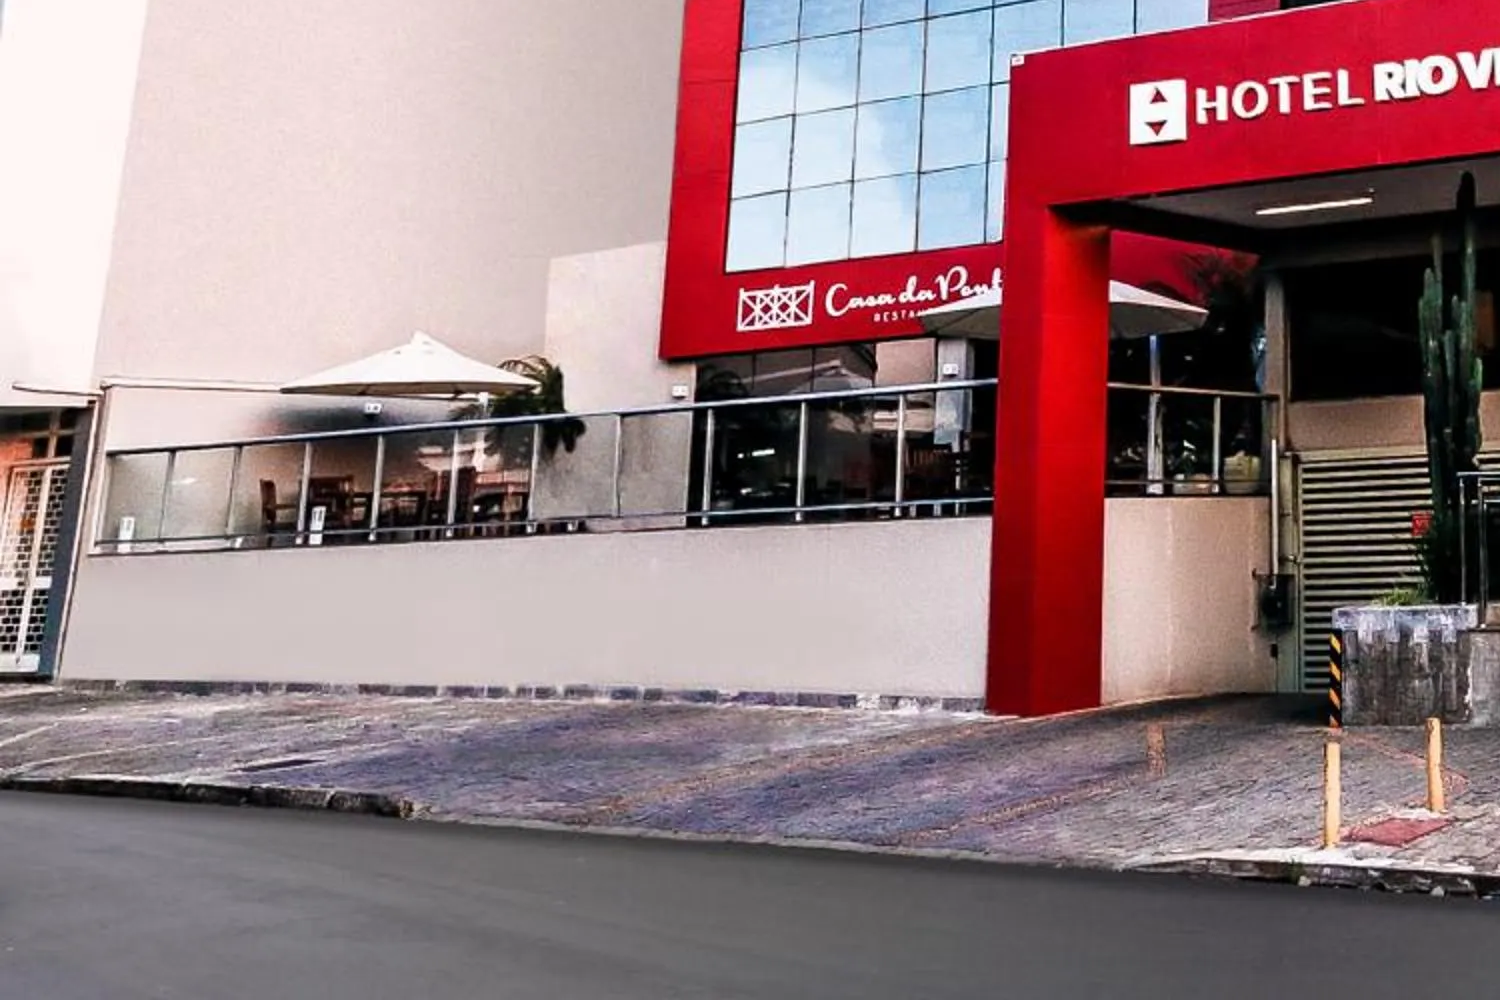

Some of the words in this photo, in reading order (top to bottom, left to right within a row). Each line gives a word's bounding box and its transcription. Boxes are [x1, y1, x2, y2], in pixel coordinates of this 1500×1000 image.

[1195, 69, 1365, 125] HOTEL
[824, 283, 896, 317] Casa
[898, 275, 936, 303] da
